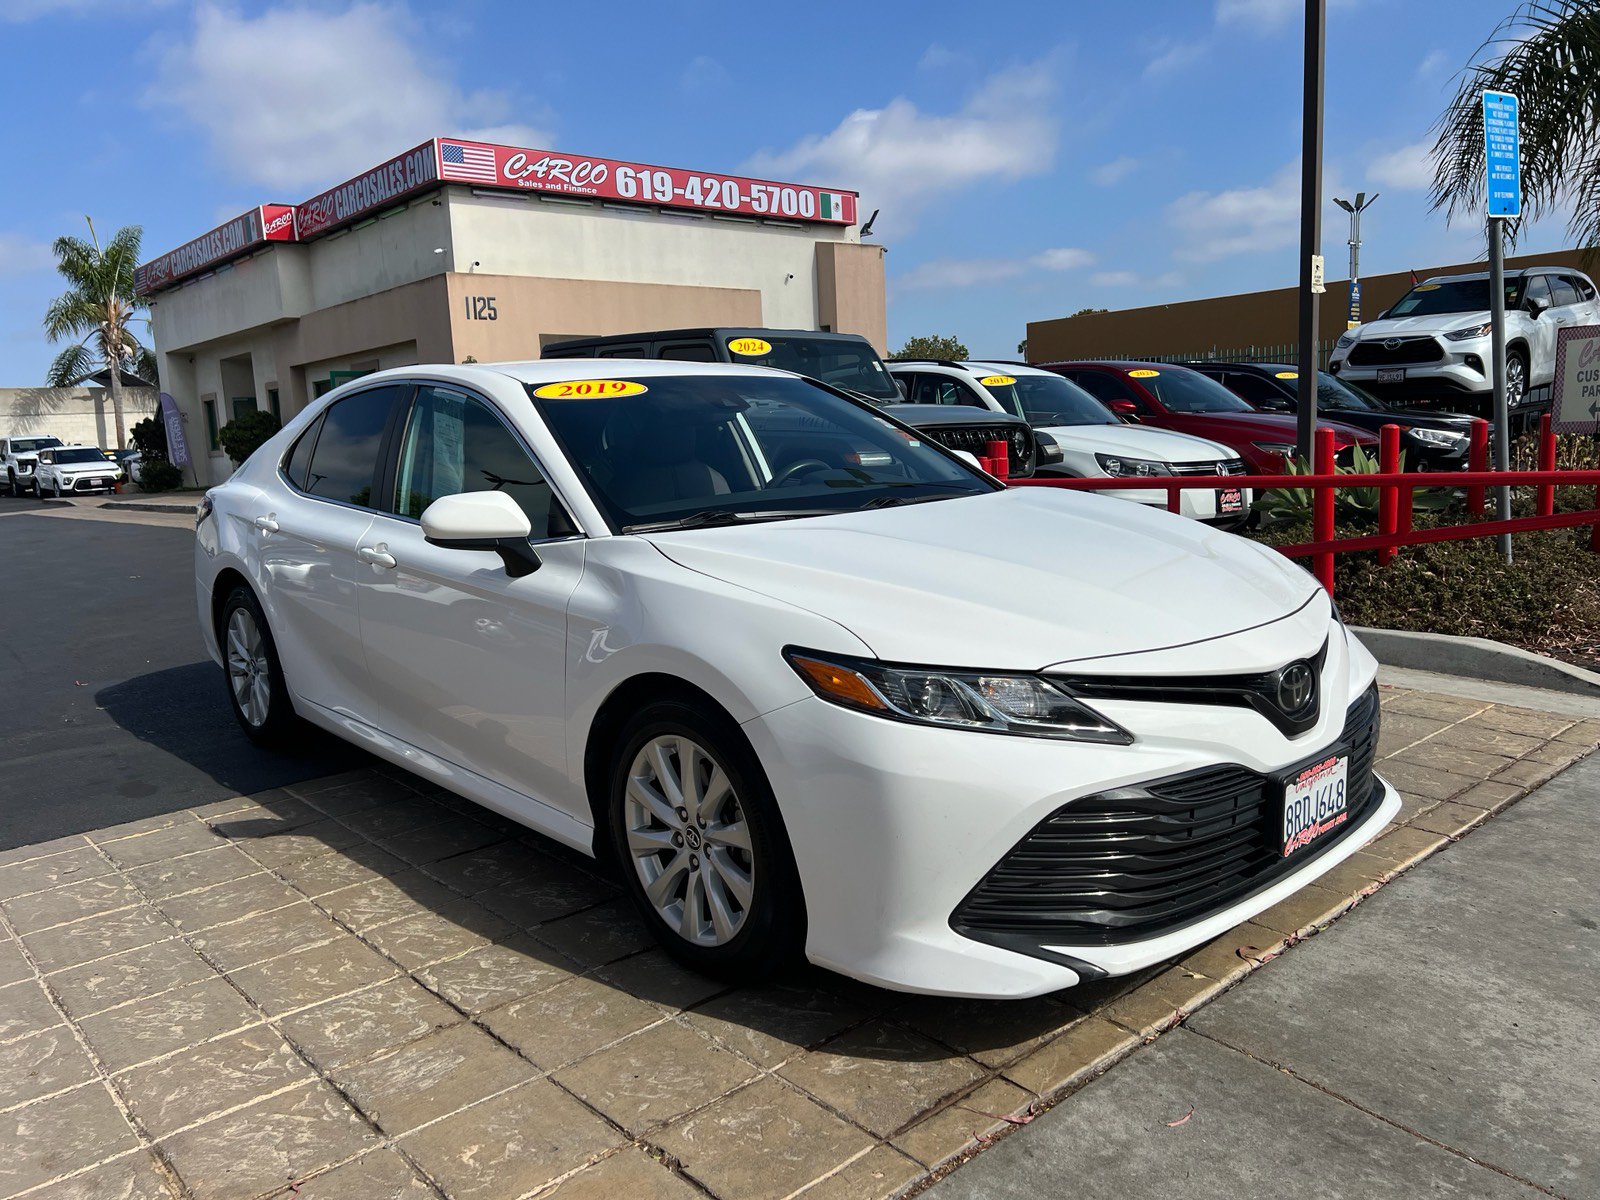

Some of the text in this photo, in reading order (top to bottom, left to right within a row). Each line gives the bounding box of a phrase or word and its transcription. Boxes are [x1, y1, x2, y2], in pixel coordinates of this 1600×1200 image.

[297, 144, 436, 233] CARCO CARCOSALES.COM
[503, 152, 815, 218] CARCO 619-420-5700
[518, 179, 598, 194] Sales and Finance
[265, 212, 292, 233] CARCO
[170, 219, 246, 277] CARCOSALES.COM
[465, 296, 498, 320] 1125
[737, 341, 764, 352] 2024
[558, 382, 627, 397] 2019
[1286, 778, 1345, 837] 8RDJ648
